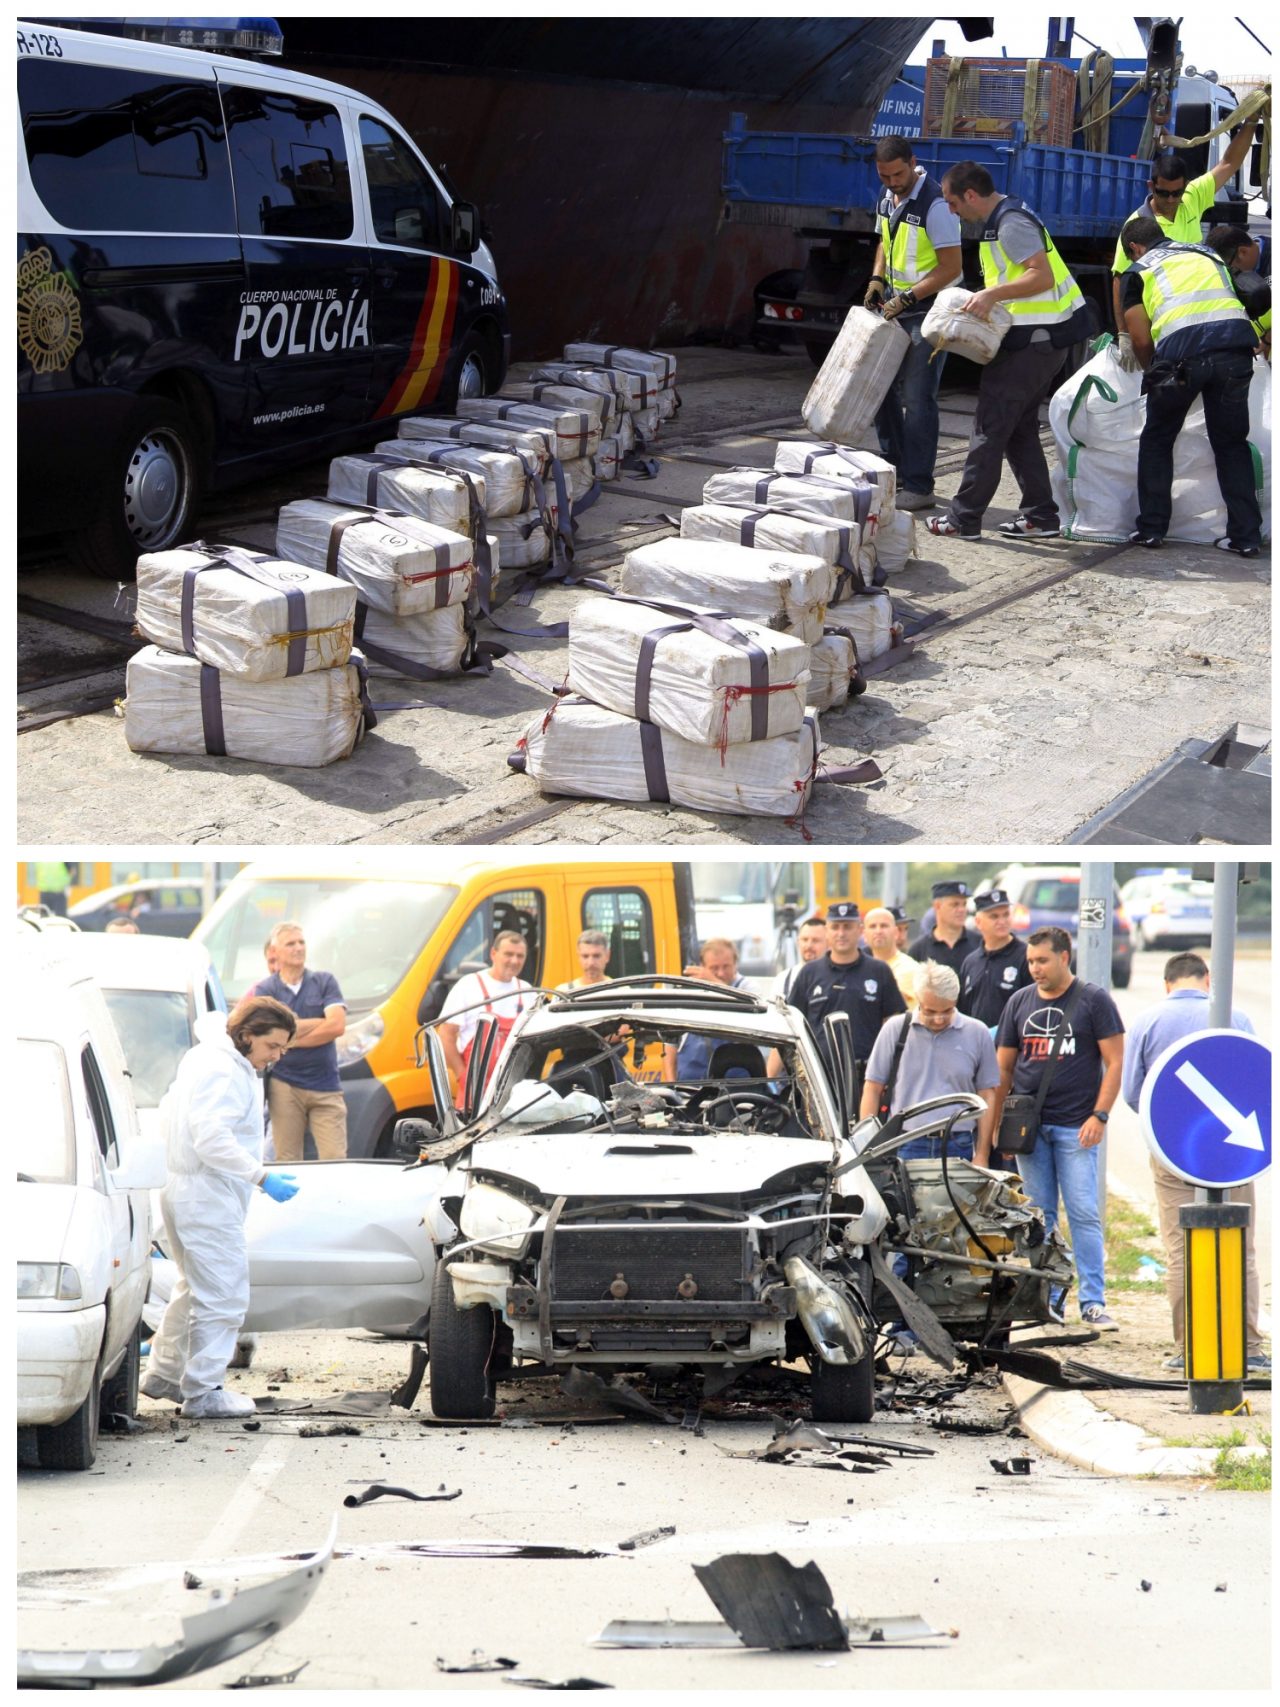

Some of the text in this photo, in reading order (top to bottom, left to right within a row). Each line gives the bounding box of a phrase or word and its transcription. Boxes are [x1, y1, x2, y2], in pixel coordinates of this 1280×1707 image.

[240, 288, 338, 304] CUERPO NACIONAL DE
[234, 289, 369, 362] POLICÍA
[252, 403, 325, 424] www.policia.es
